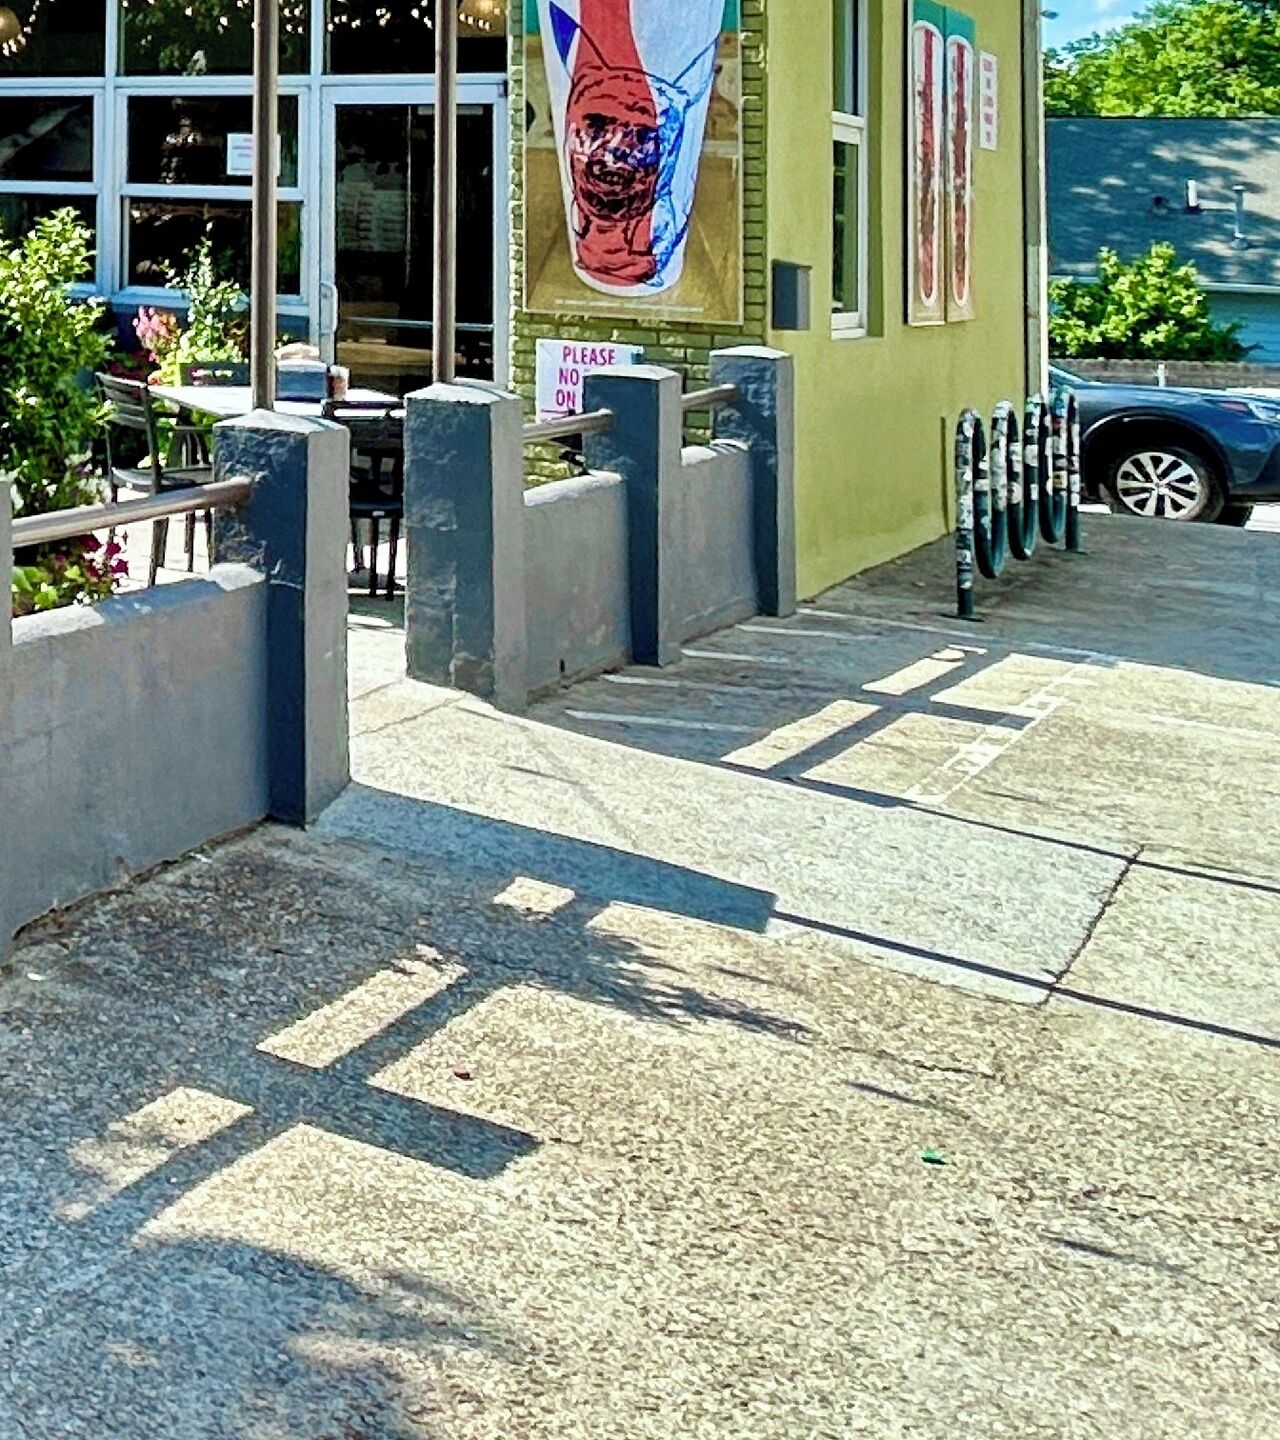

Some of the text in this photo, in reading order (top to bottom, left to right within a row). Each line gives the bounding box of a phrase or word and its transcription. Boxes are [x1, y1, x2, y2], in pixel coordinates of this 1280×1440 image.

[562, 345, 615, 366] PLEASE
[558, 367, 580, 386] NO
[555, 388, 576, 408] ON
